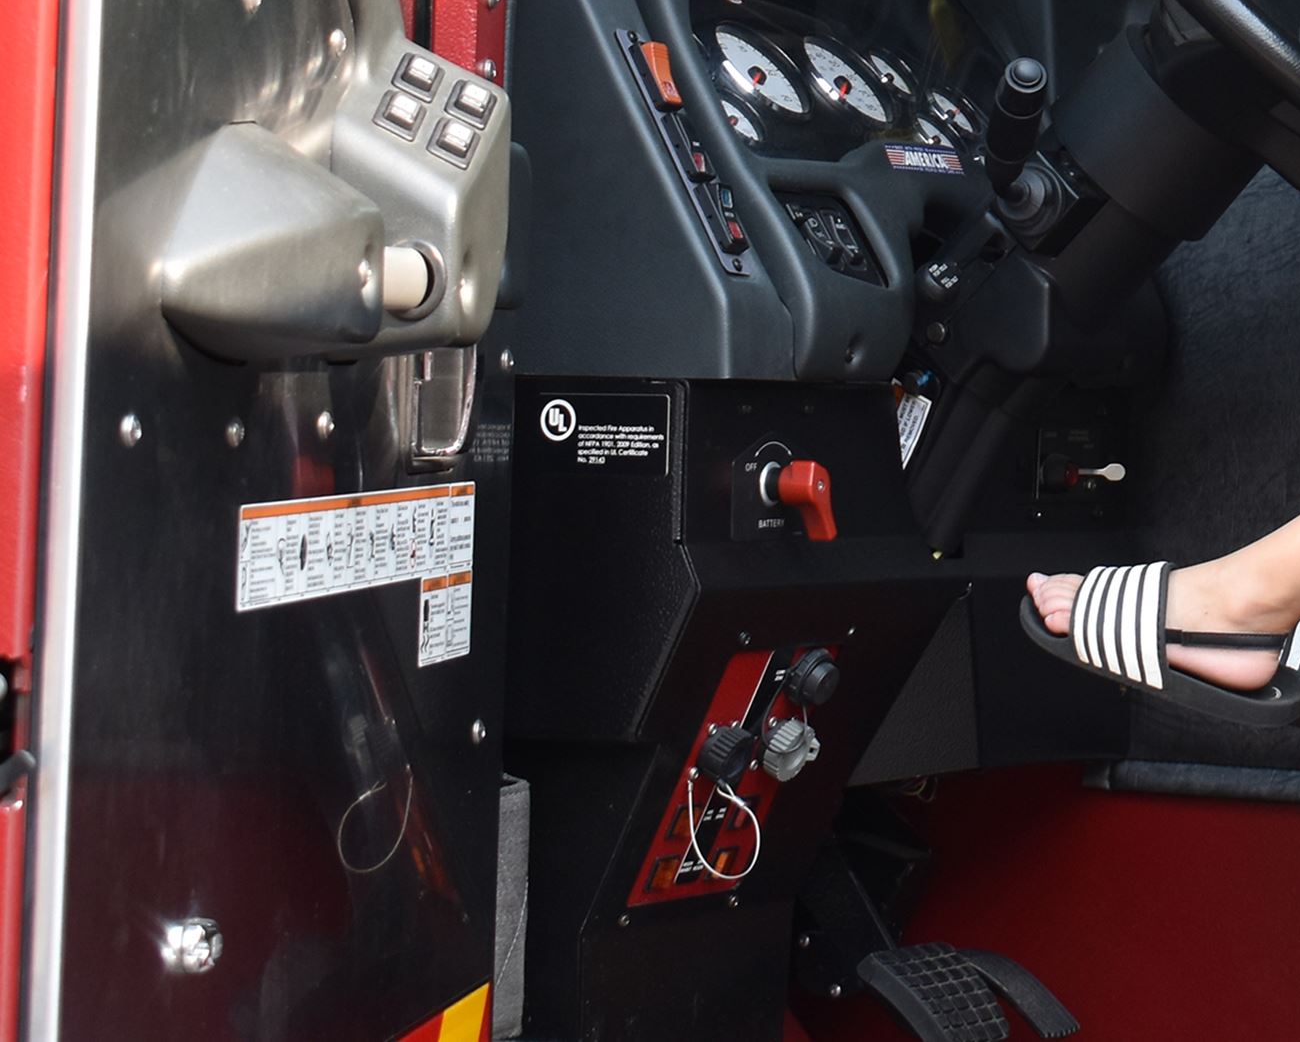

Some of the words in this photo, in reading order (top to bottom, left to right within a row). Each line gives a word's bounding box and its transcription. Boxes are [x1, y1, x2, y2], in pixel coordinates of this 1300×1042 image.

[904, 151, 949, 170] AMERICA
[548, 407, 567, 432] UL
[578, 425, 607, 433] Inspected
[618, 425, 648, 433] Apparatus
[577, 448, 604, 456] specified
[744, 462, 758, 472] OFF
[757, 518, 785, 529] BATTERY
